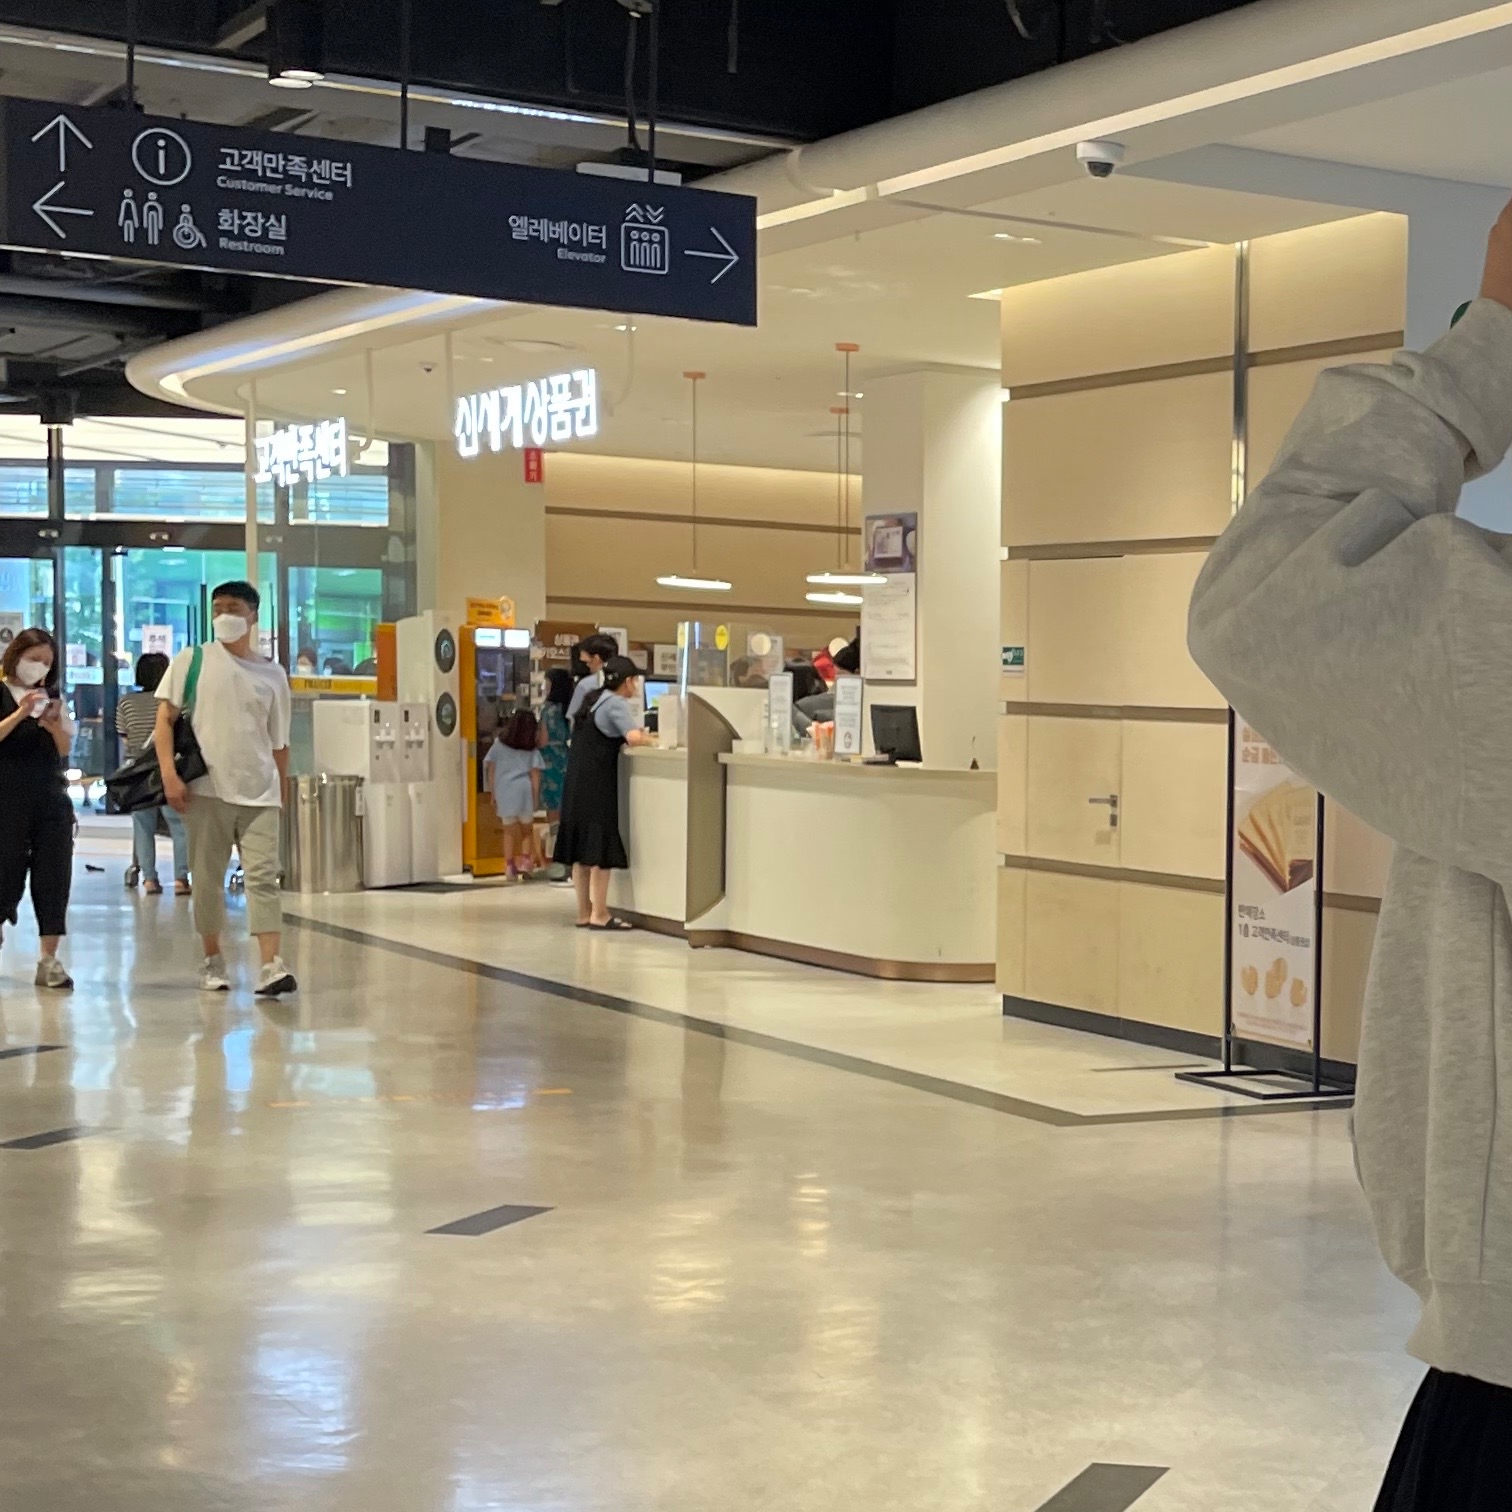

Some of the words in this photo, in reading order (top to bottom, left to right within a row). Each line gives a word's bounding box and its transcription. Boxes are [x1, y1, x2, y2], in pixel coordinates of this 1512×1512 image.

[218, 148, 352, 187] 고객만족센터
[216, 175, 283, 196] Customer
[284, 185, 334, 201] Service
[217, 208, 287, 240] 화장실
[508, 215, 606, 249] 엘레베이터
[219, 237, 285, 255] Restroom
[557, 248, 606, 264] Elevator
